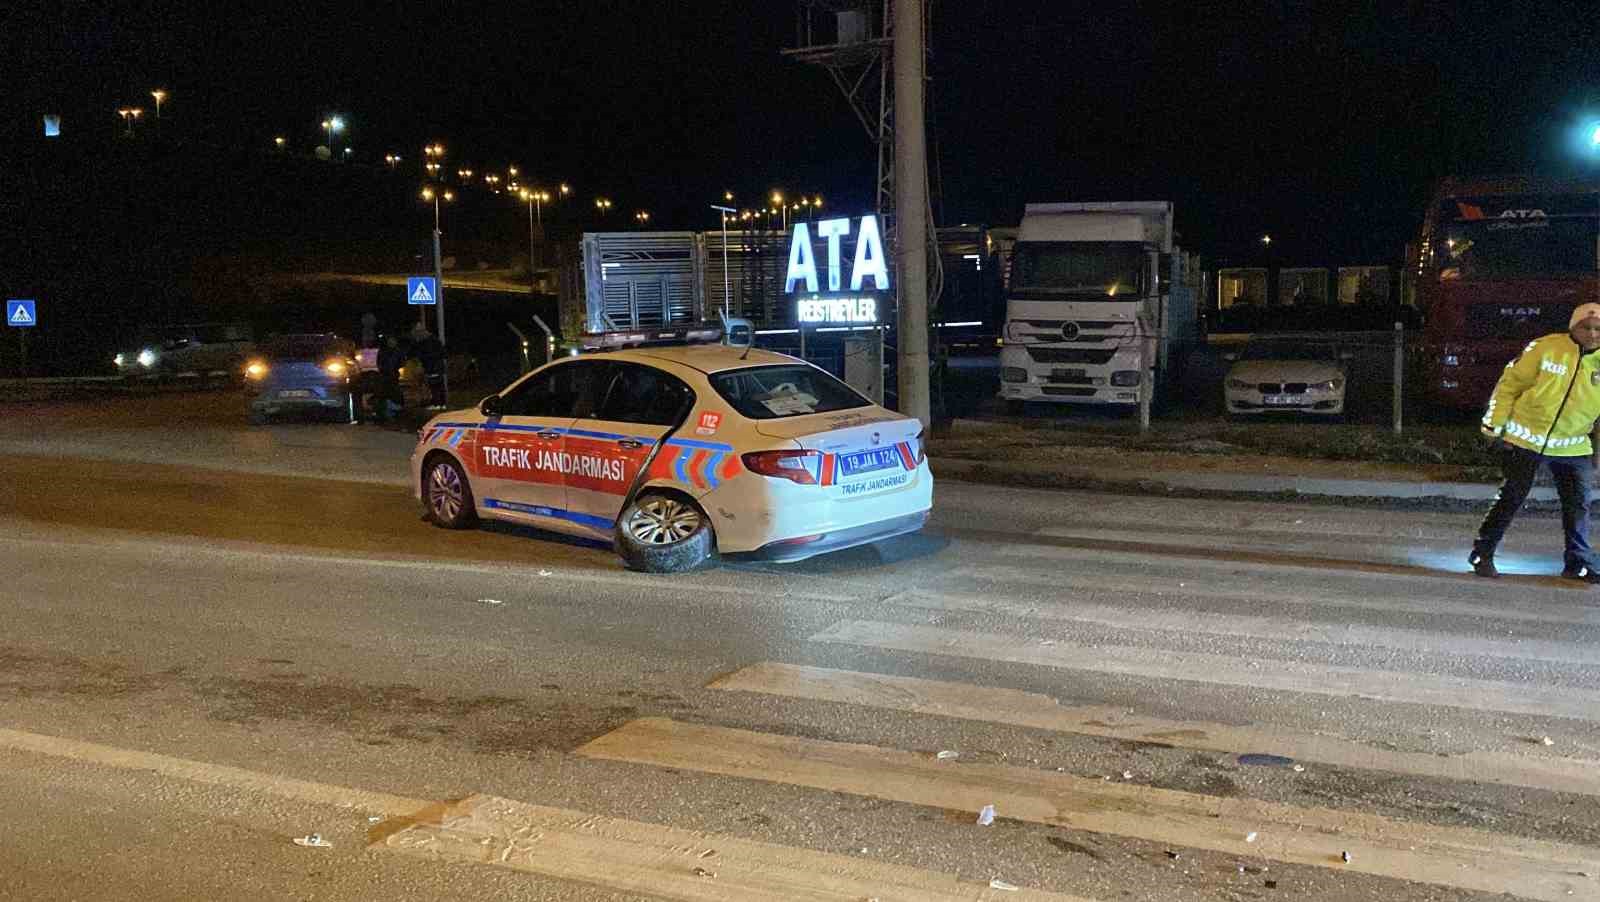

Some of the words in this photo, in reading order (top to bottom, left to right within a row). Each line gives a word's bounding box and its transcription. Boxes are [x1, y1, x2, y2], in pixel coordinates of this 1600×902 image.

[1499, 208, 1545, 219] ATA
[784, 214, 889, 294] ATA
[702, 414, 719, 428] 112
[535, 450, 625, 481] JANDARMASI
[848, 455, 859, 472] 19
